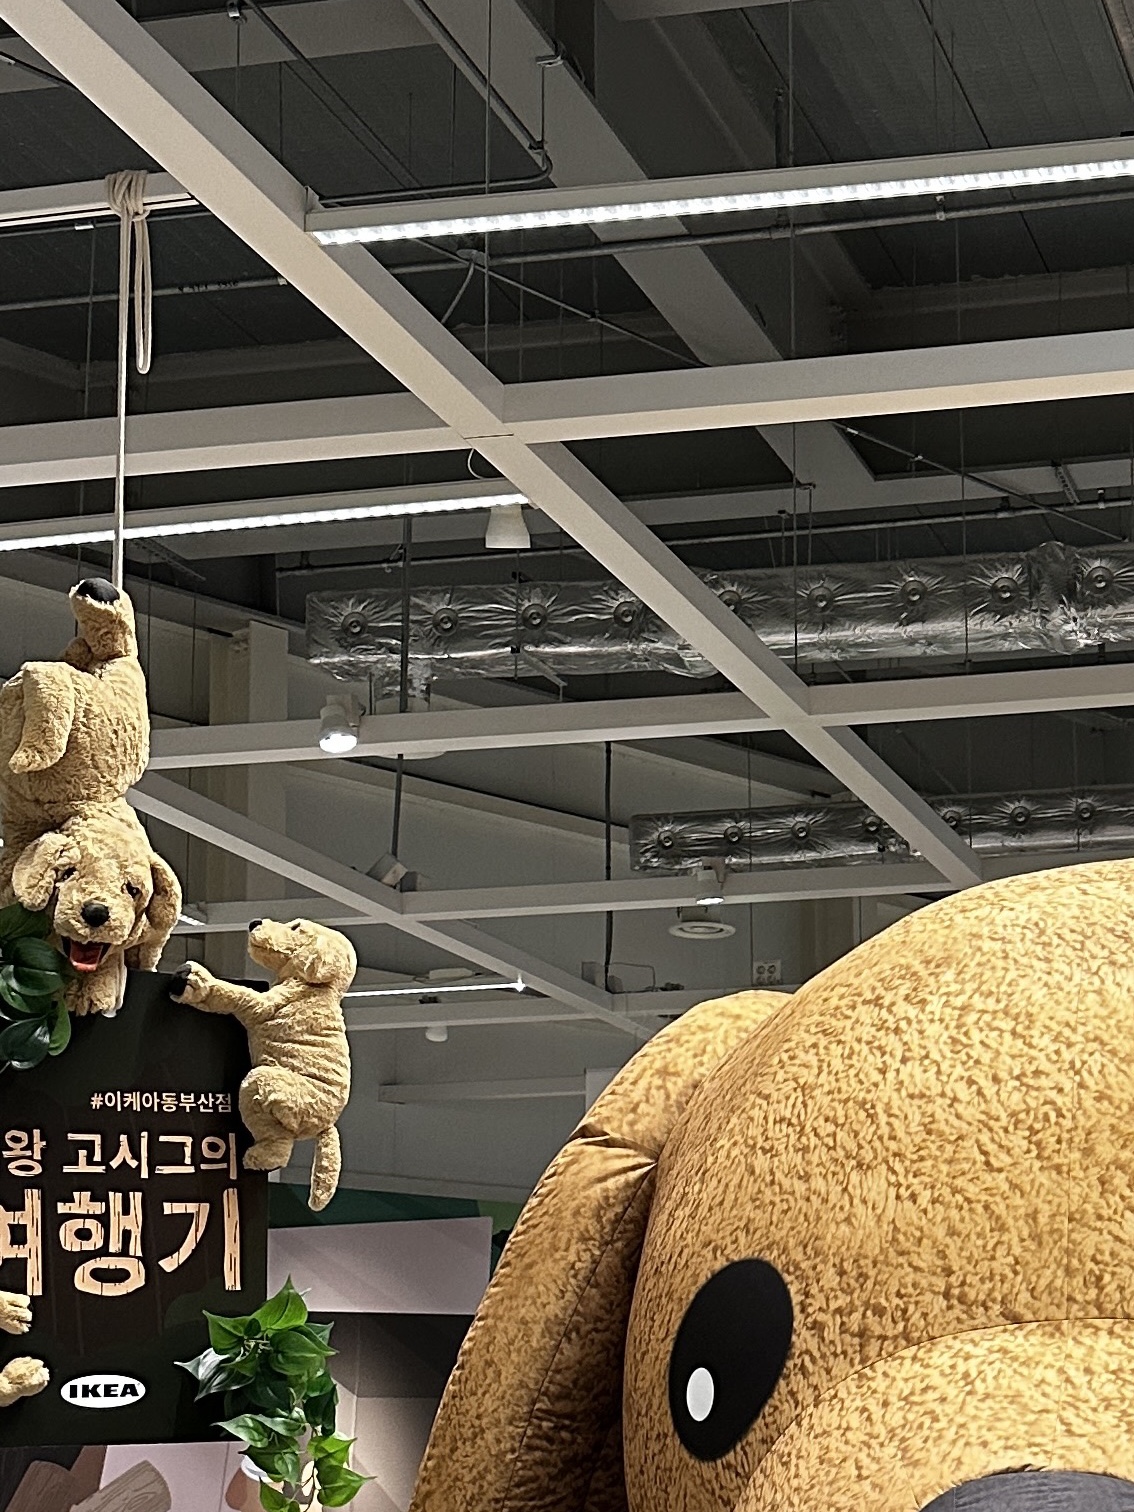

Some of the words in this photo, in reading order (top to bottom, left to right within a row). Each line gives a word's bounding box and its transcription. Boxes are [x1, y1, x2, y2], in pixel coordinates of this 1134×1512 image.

[90, 1090, 232, 1113] #이케아동부산점
[62, 1131, 238, 1180] 고시그의
[69, 1383, 140, 1399] IKEA
